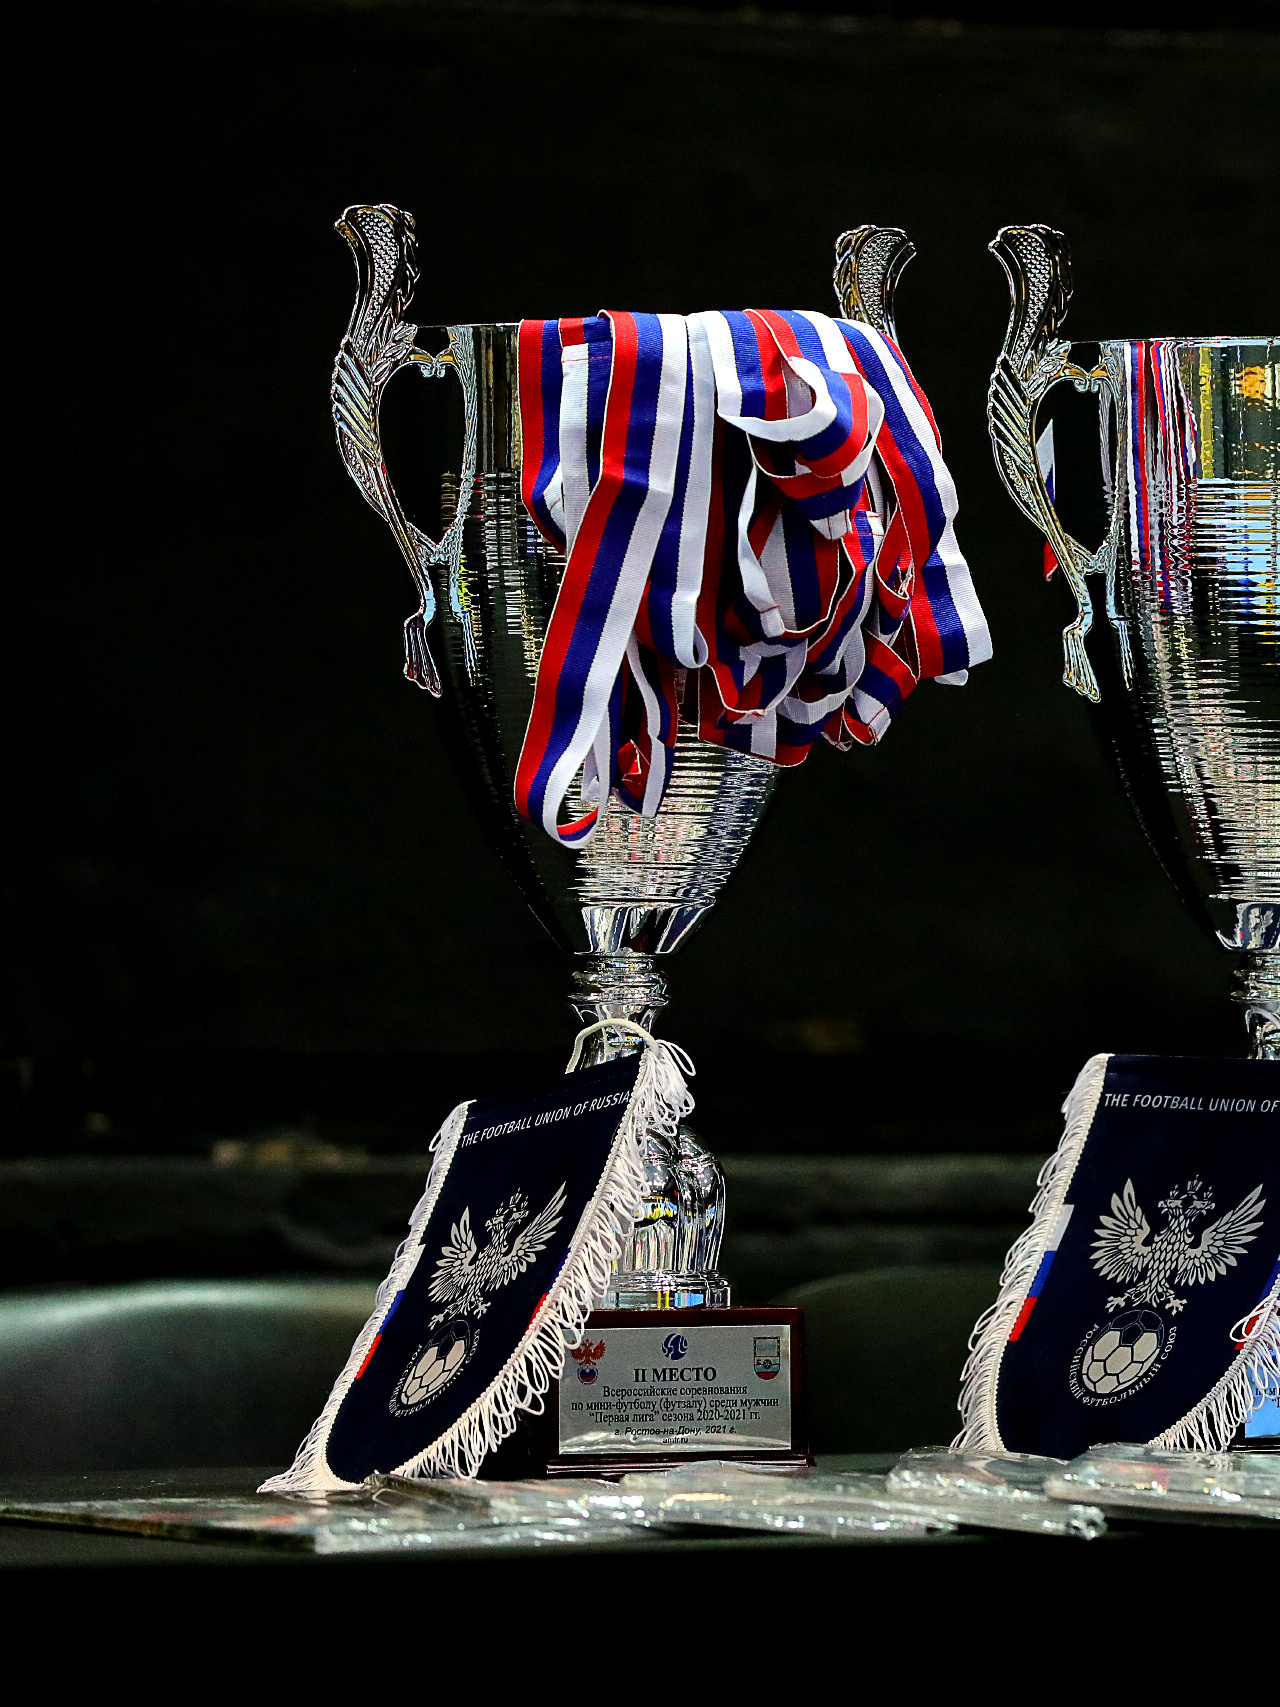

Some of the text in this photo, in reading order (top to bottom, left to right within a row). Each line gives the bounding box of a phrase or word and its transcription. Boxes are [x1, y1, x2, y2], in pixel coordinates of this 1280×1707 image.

[1104, 1094, 1130, 1107] THE
[1132, 1095, 1203, 1110] FOOTBALL
[1209, 1098, 1256, 1113] UNION
[1261, 1100, 1280, 1113] OF
[461, 1091, 631, 1148] THE FOOTBALL UNION OF RUSSIA
[1069, 1323, 1177, 1406] РОССИЙСКИЙ ФУТБОЛЬНЫЙ СОЮЗ
[652, 1367, 716, 1382] МЕСТО
[603, 1386, 747, 1398] Всероссийские соревнования
[571, 1398, 779, 1412] по мини-футболу (футзалу) среди мужчин
[662, 1413, 694, 1422] сезона
[697, 1409, 746, 1421] 2020-2021
[625, 1426, 701, 1436] Ростов-на-Дону,
[705, 1426, 727, 1434] 2021
